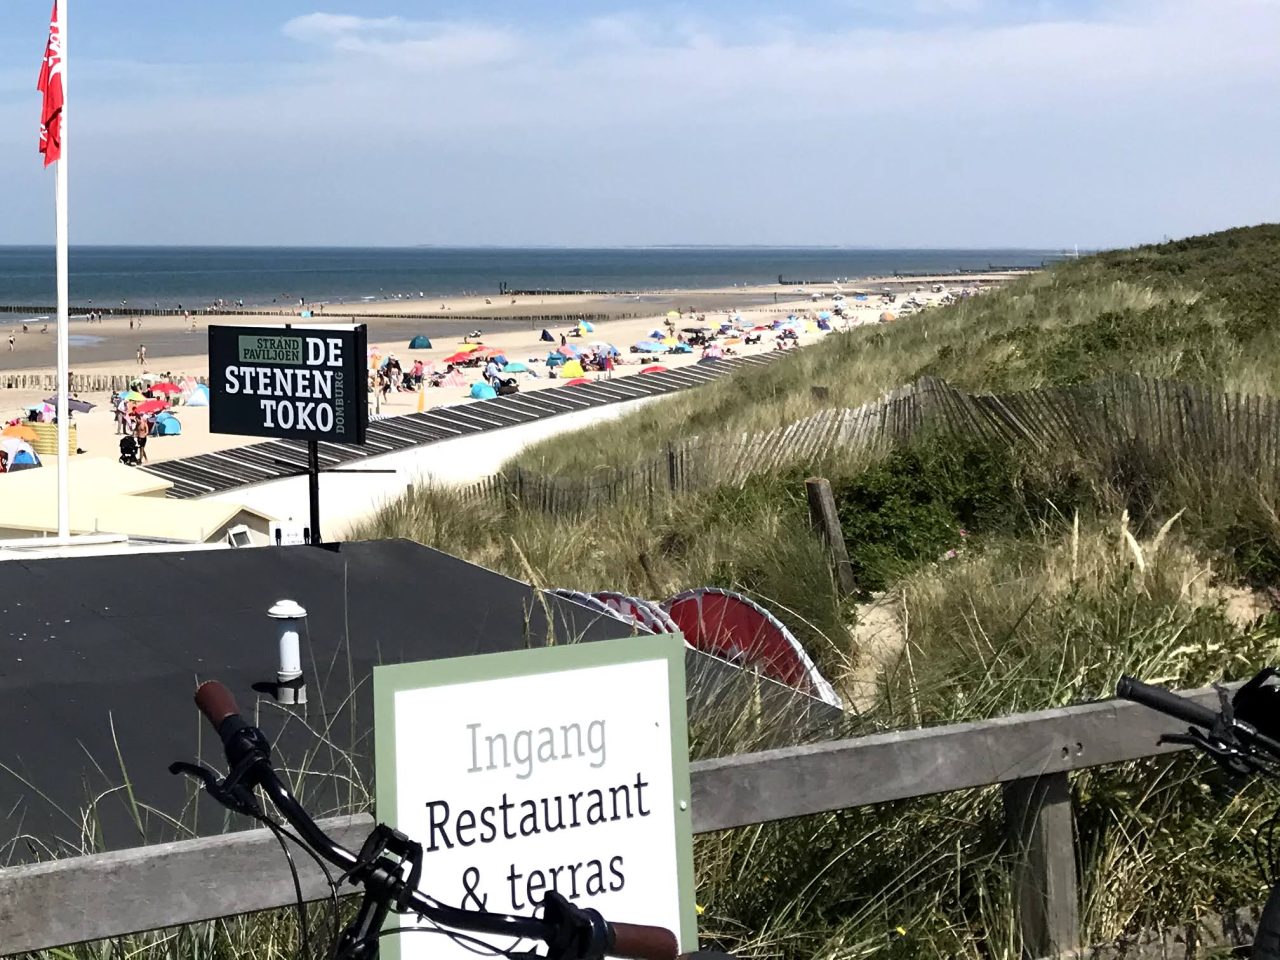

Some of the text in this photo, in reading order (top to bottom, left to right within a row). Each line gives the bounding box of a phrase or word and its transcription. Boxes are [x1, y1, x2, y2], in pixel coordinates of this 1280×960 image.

[243, 348, 299, 361] PAVILJOEN
[257, 338, 299, 350] STRAND
[306, 337, 343, 367] DE
[225, 365, 334, 399] STENEN
[260, 400, 334, 432] TOKO
[335, 371, 345, 434] DOMBURG
[466, 718, 607, 780] Ingang
[425, 772, 651, 853] Restaurant
[460, 854, 626, 913] & terras
